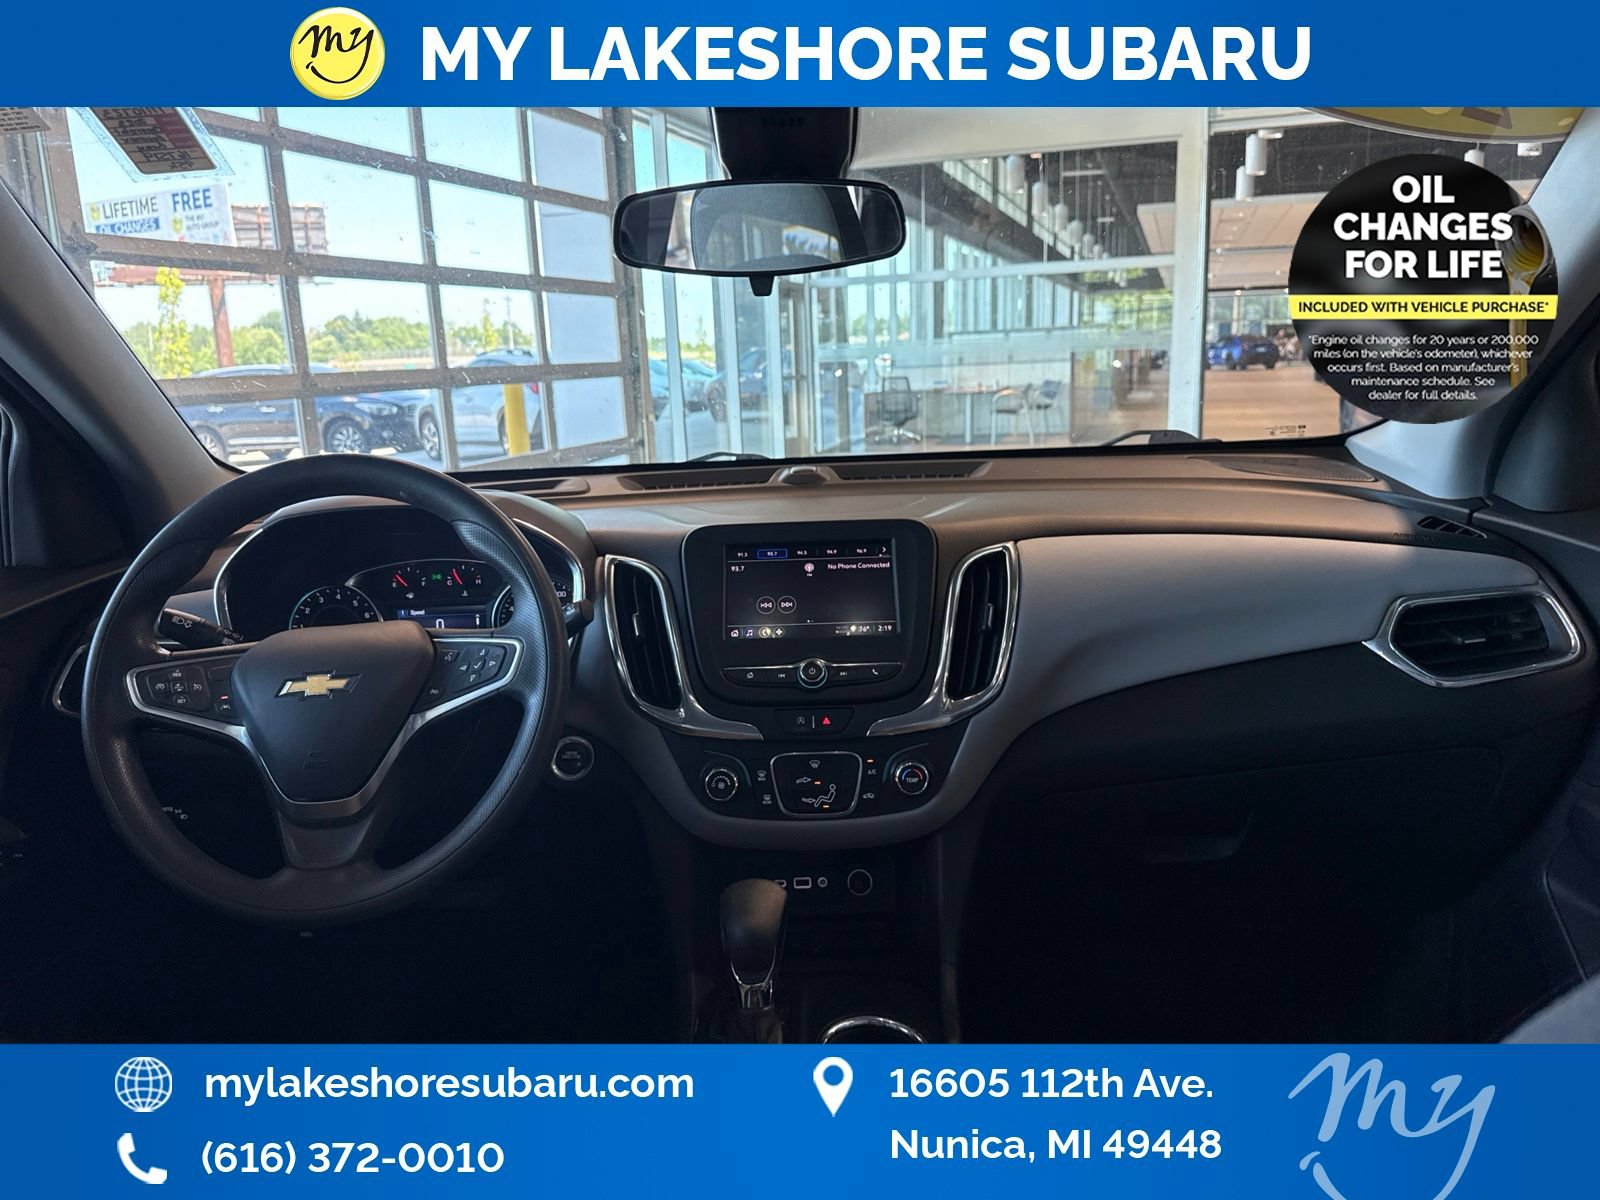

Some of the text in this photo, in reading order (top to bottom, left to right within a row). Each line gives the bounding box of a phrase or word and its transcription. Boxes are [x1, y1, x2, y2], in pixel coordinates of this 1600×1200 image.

[102, 196, 159, 219] LIFETIME
[172, 188, 213, 212] FREE
[115, 218, 156, 233] CHANGES
[410, 609, 426, 617] Speed
